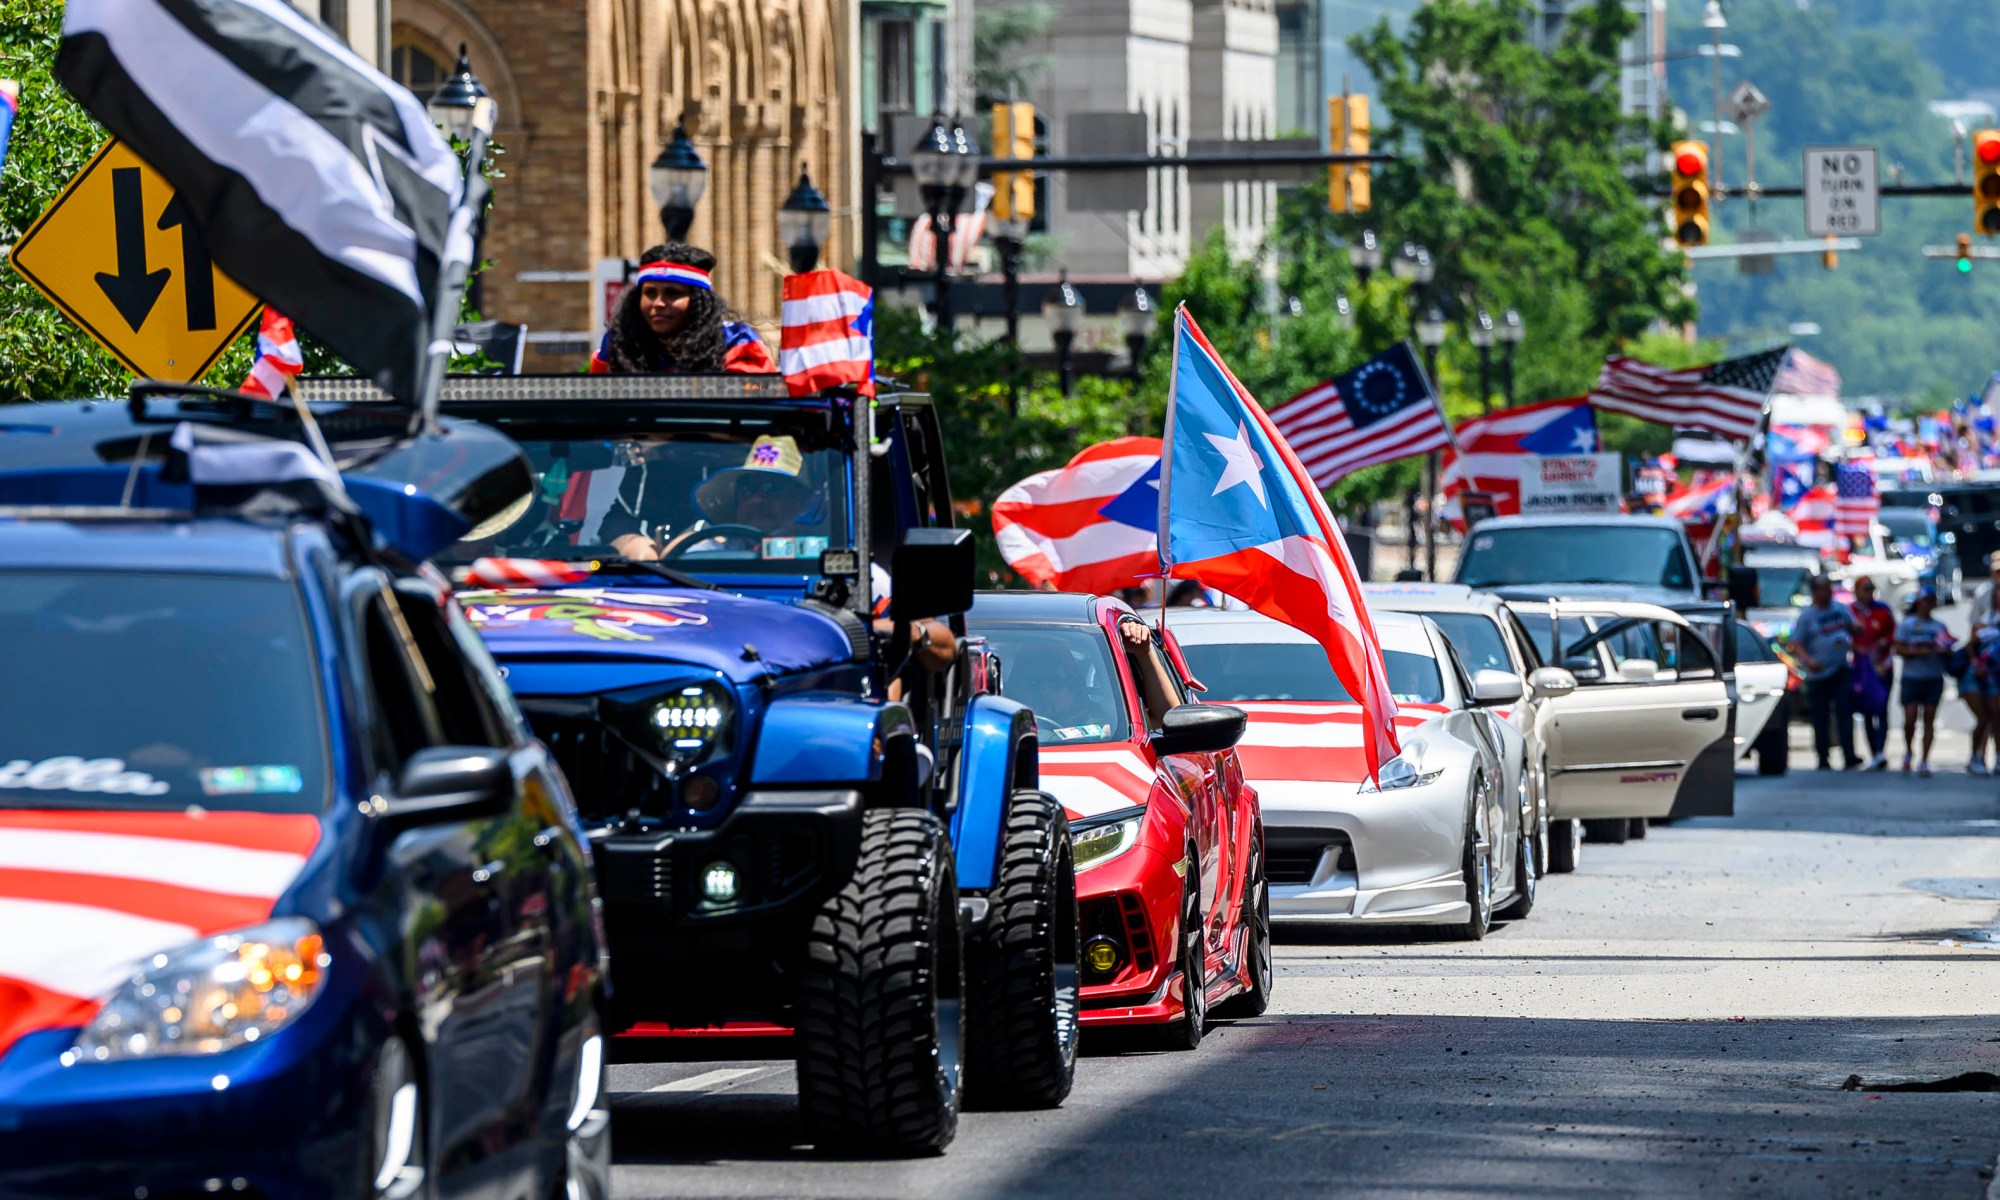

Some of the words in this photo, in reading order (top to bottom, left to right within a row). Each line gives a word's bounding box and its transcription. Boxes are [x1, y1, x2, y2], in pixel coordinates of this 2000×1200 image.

[1822, 154, 1860, 175] NO
[1821, 178, 1864, 192] TURN
[1829, 196, 1856, 211] ON
[1826, 213, 1860, 229] RED
